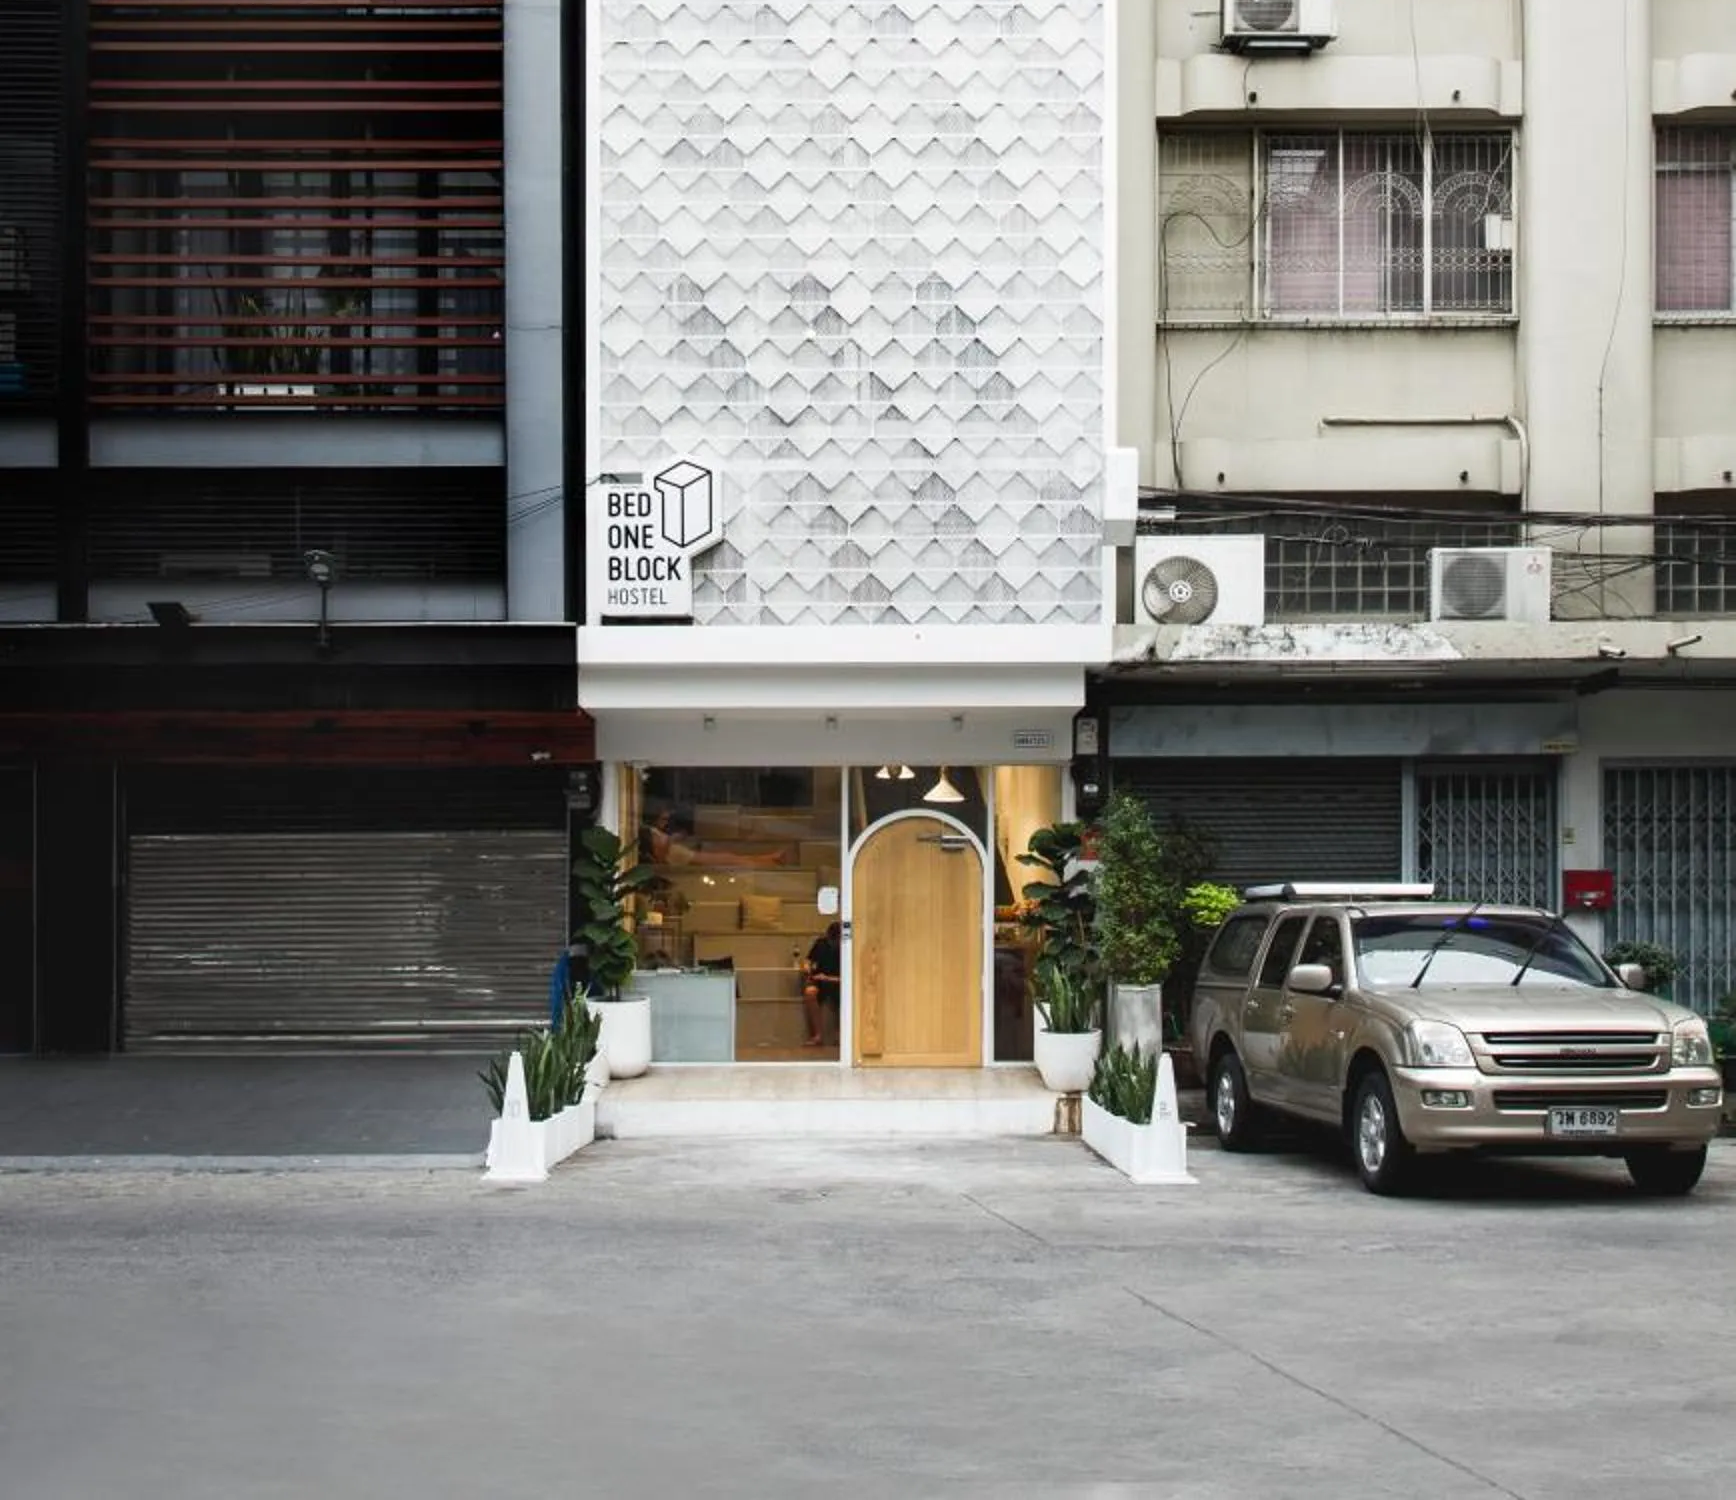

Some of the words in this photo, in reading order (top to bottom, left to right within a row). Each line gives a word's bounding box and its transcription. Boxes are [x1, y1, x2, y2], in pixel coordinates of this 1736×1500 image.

[608, 492, 651, 517] BED
[608, 524, 654, 549] ONE
[608, 556, 681, 581] BLOCK
[608, 588, 668, 605] HOSTEL
